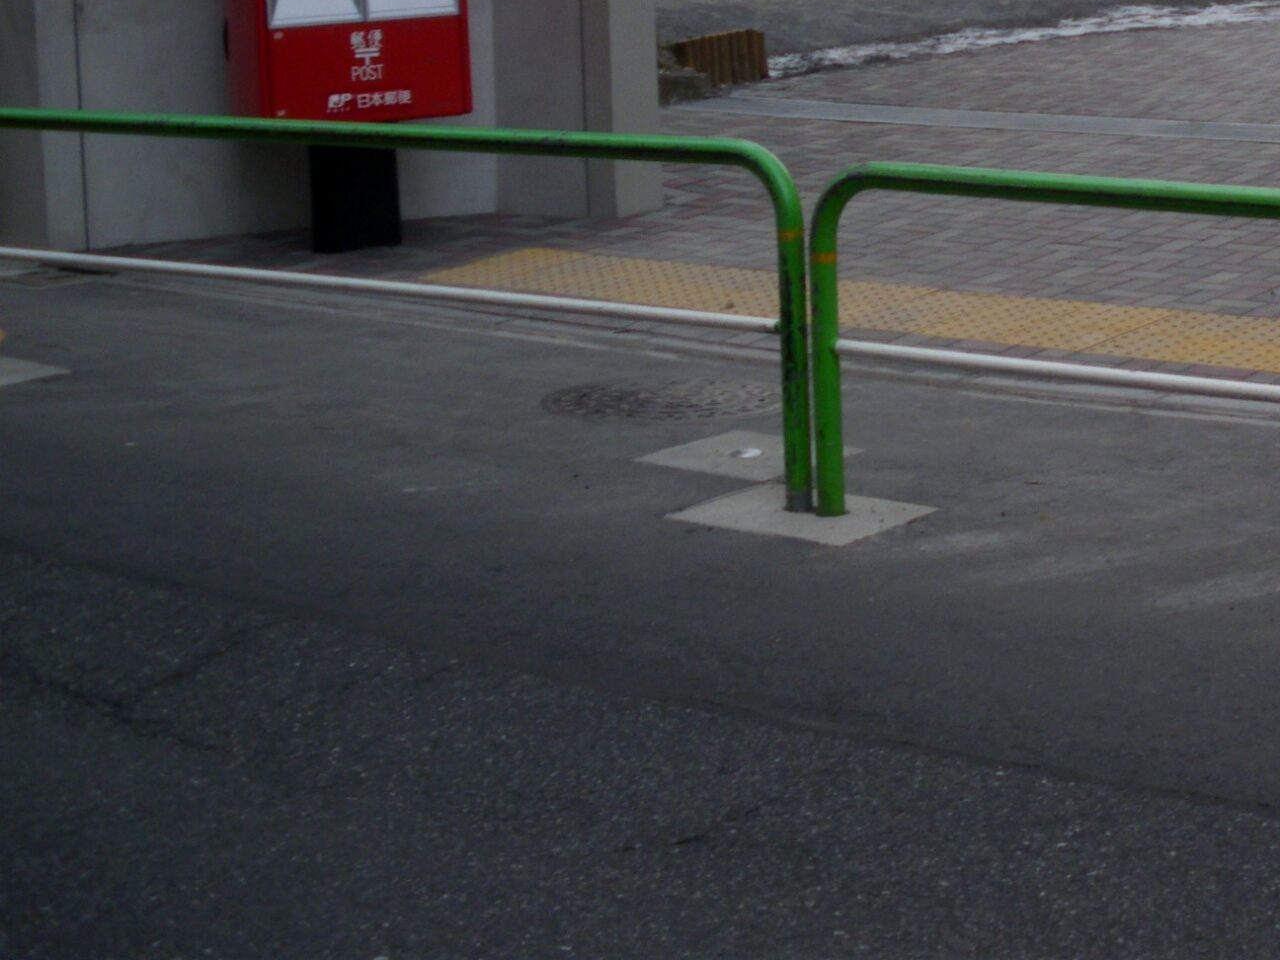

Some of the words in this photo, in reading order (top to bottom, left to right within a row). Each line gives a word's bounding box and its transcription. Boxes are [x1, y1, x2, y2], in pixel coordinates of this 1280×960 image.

[350, 28, 383, 50] 郵便
[351, 64, 384, 82] POST
[357, 89, 412, 109] 日本郵便
